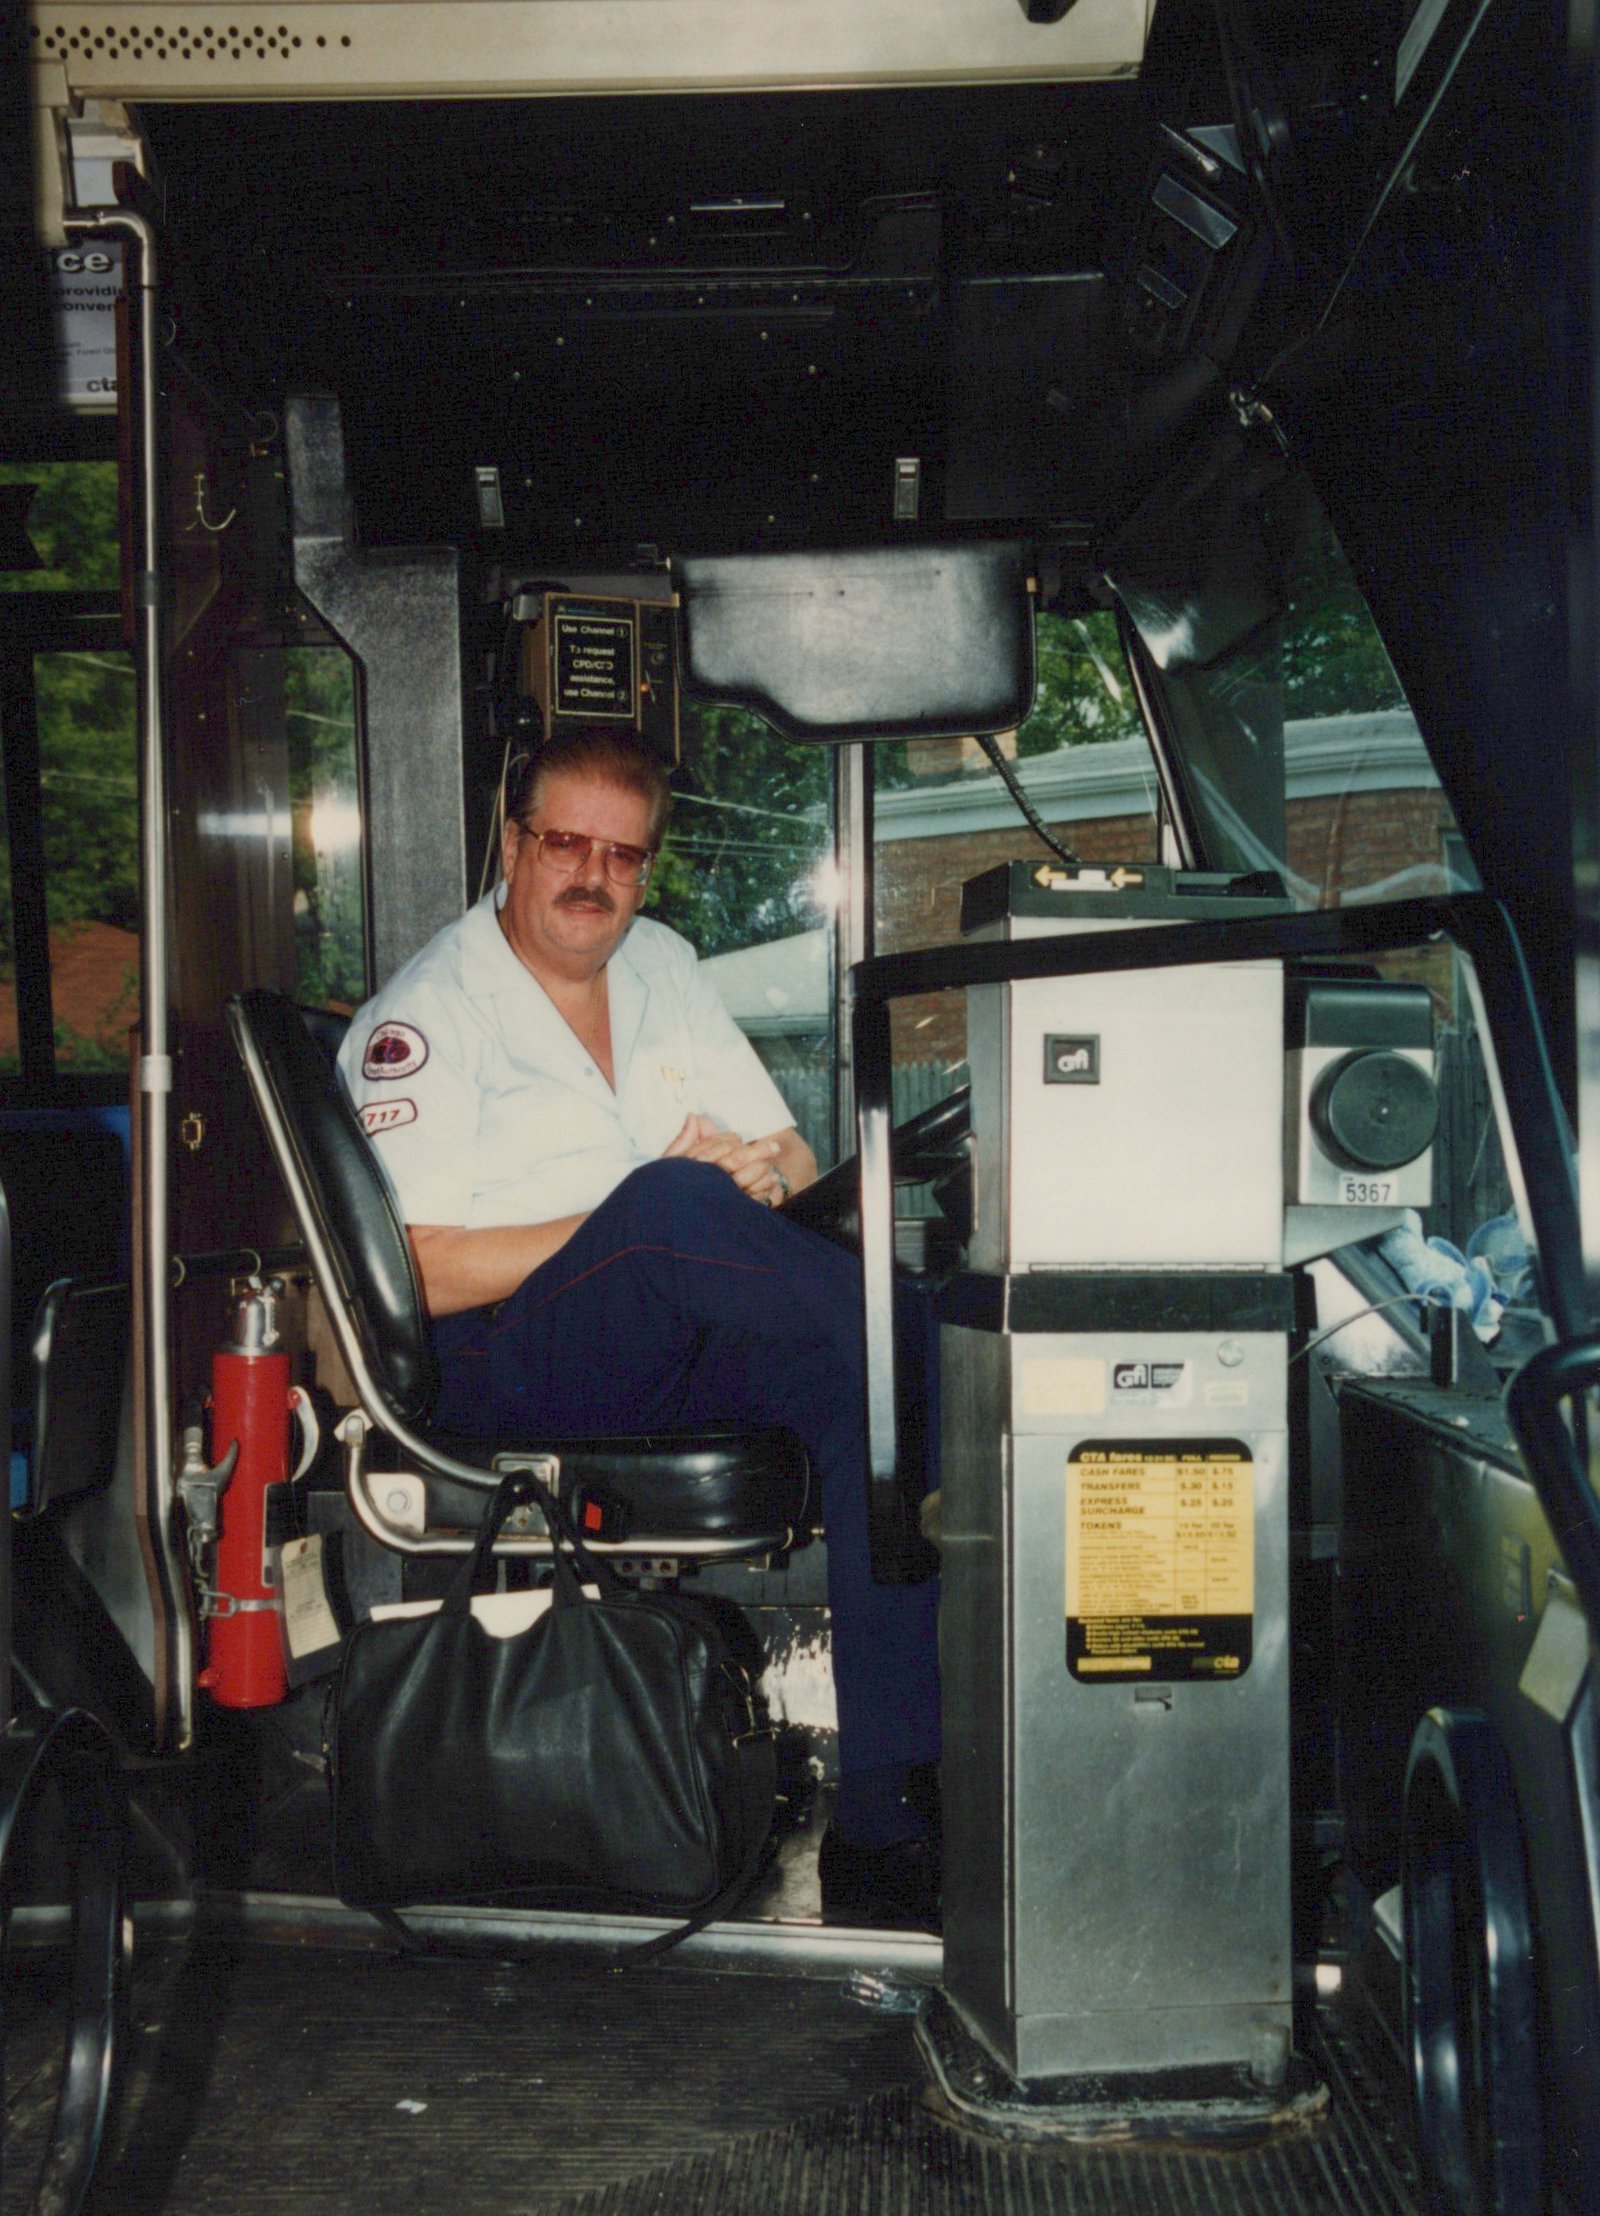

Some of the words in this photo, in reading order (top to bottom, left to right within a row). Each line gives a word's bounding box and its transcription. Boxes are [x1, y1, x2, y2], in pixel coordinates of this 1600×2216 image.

[561, 624, 578, 634] Use
[580, 625, 615, 636] Channel
[569, 644, 581, 654] To
[583, 646, 615, 657] request
[563, 688, 579, 697] use
[580, 688, 615, 699] Channel
[366, 1108, 401, 1127] 717
[1346, 1183, 1391, 1202] 5367
[1080, 1467, 1109, 1476] CASH
[1112, 1467, 1145, 1476] FARES
[1080, 1482, 1141, 1491] TRANSFERS
[1080, 1497, 1128, 1506] EXPRESS
[1080, 1506, 1145, 1516] SURCHARGE
[1080, 1521, 1122, 1530] TOKENS
